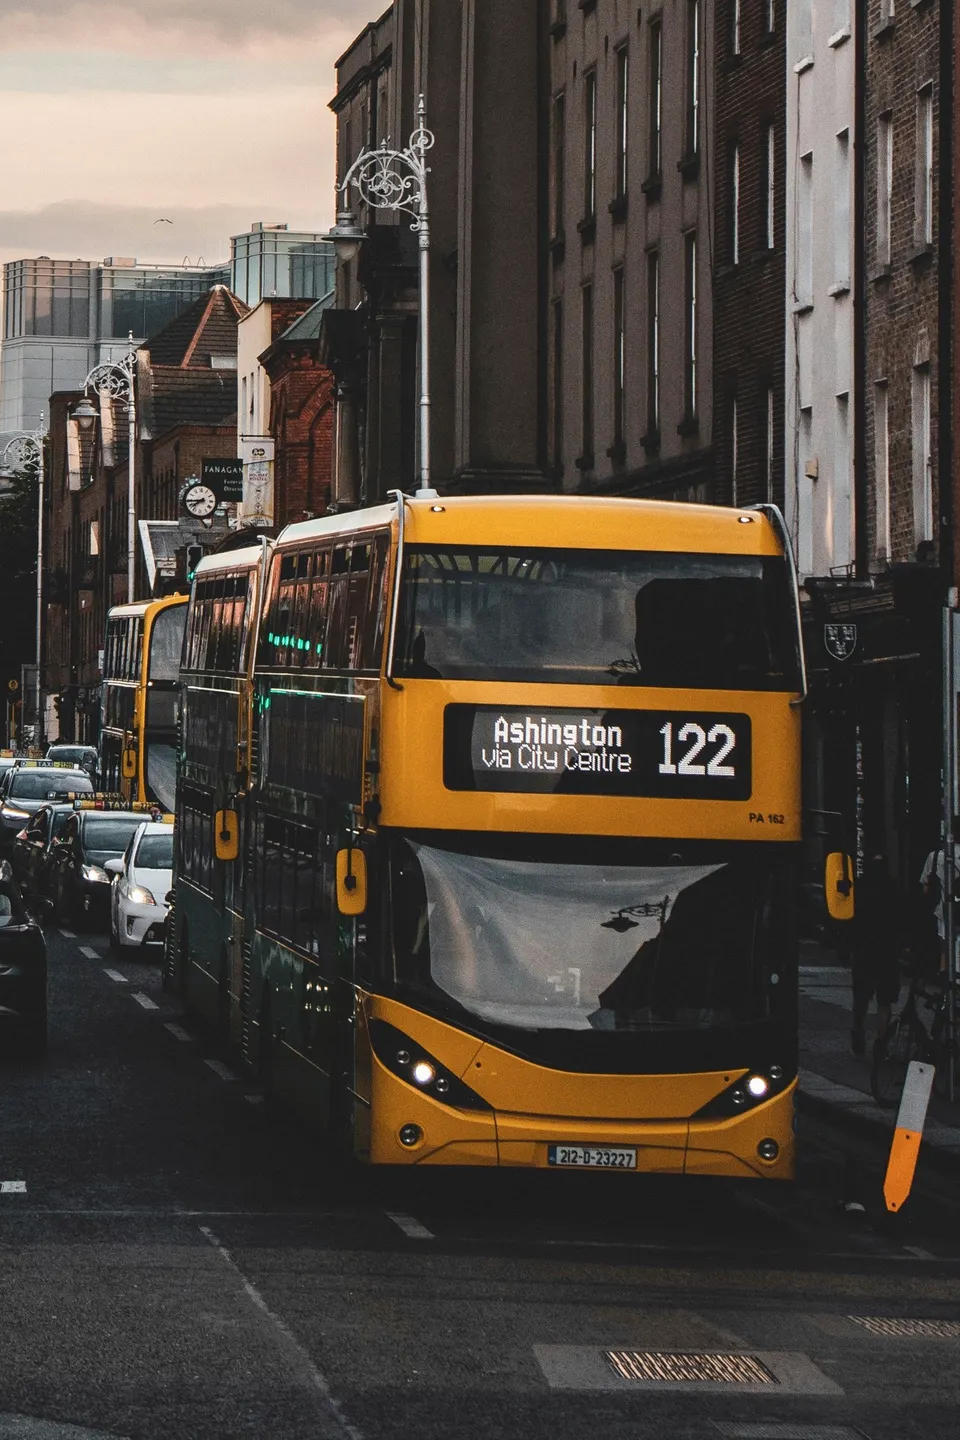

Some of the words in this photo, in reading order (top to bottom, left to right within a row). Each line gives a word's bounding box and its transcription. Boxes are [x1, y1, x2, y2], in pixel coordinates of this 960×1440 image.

[493, 716, 622, 747] Ashington
[658, 722, 736, 777] 122
[481, 746, 512, 769] via
[517, 745, 559, 770] City
[563, 745, 632, 773] Centre
[76, 792, 95, 800] TAXI
[108, 801, 130, 809] TAXI
[749, 813, 765, 824] PA
[767, 814, 785, 825] 162
[560, 1149, 633, 1168] 212-D-23227
